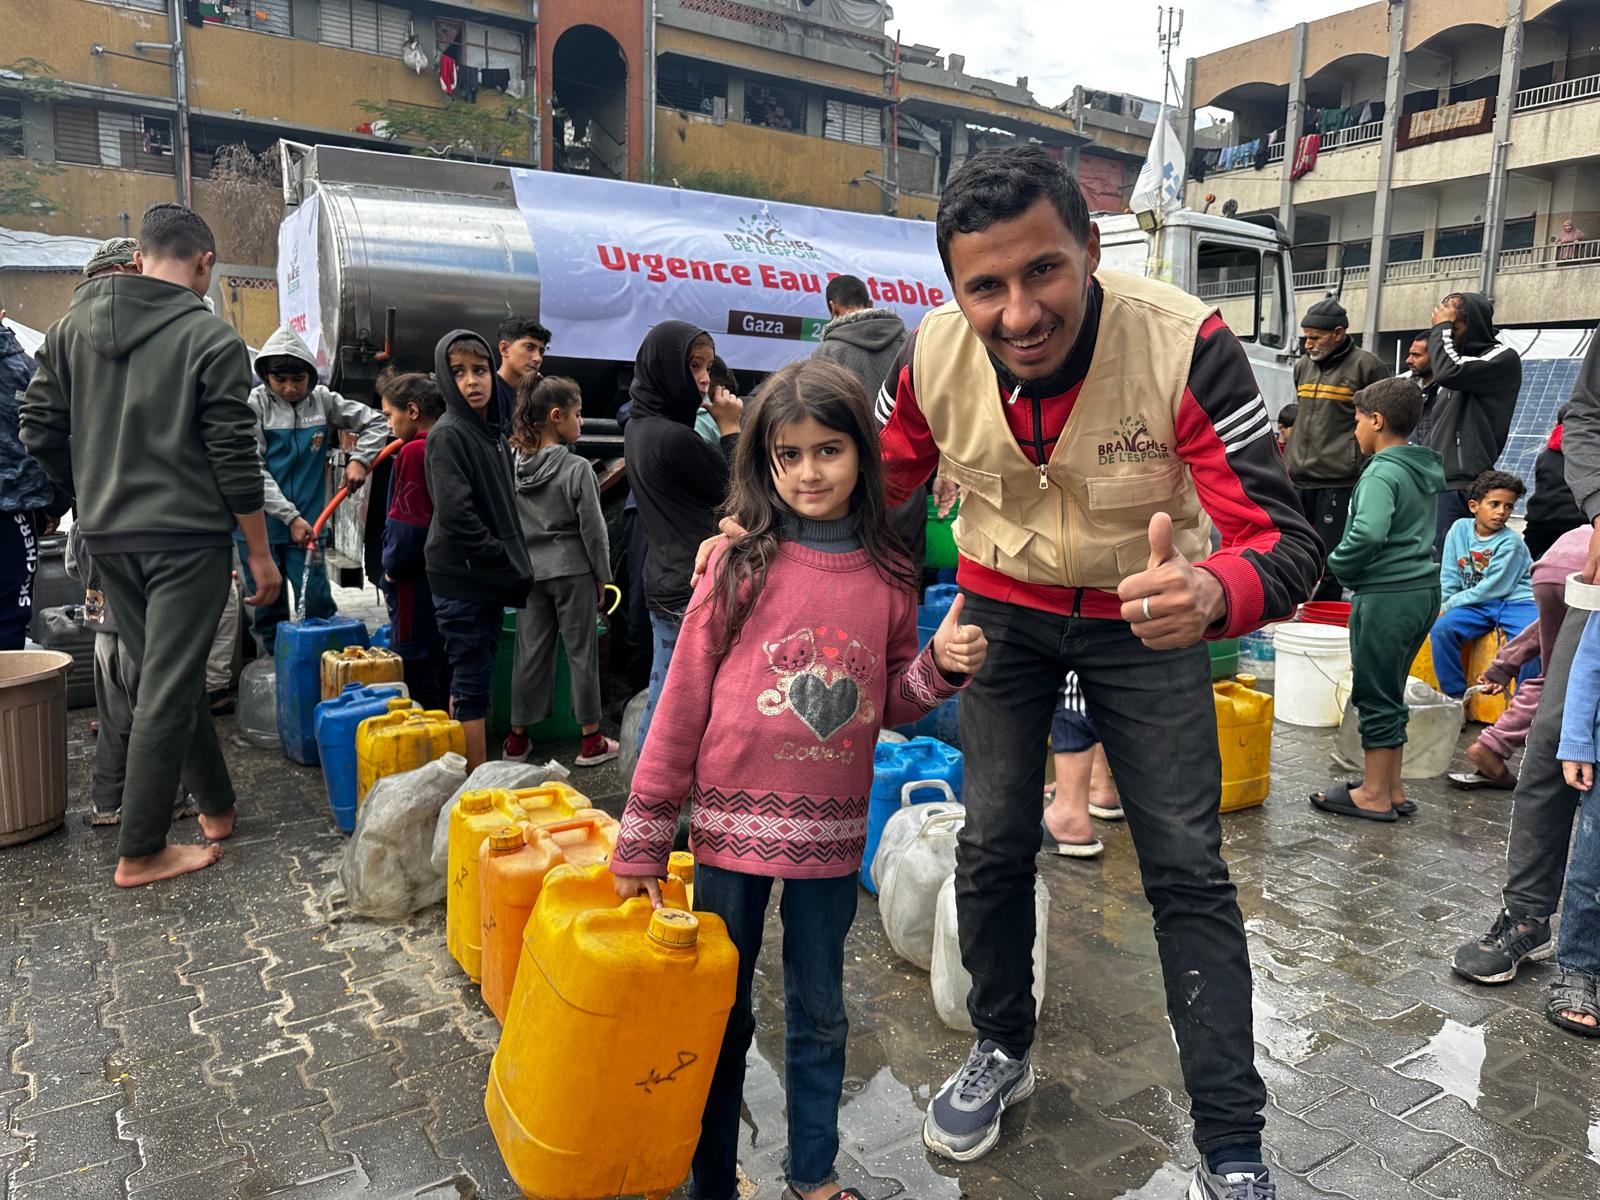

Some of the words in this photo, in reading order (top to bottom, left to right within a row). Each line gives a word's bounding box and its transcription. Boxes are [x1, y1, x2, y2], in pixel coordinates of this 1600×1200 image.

[723, 231, 814, 251] BRANCHES
[731, 242, 753, 252] DE
[597, 245, 752, 286] Urgence
[758, 264, 822, 293] Eau
[826, 272, 945, 308] table
[742, 315, 785, 335] Gaza
[1098, 437, 1168, 456] BRANCHES
[1098, 453, 1115, 466] DE
[1119, 450, 1170, 463] L'ESPOIR
[14, 513, 37, 607] SKCHERS
